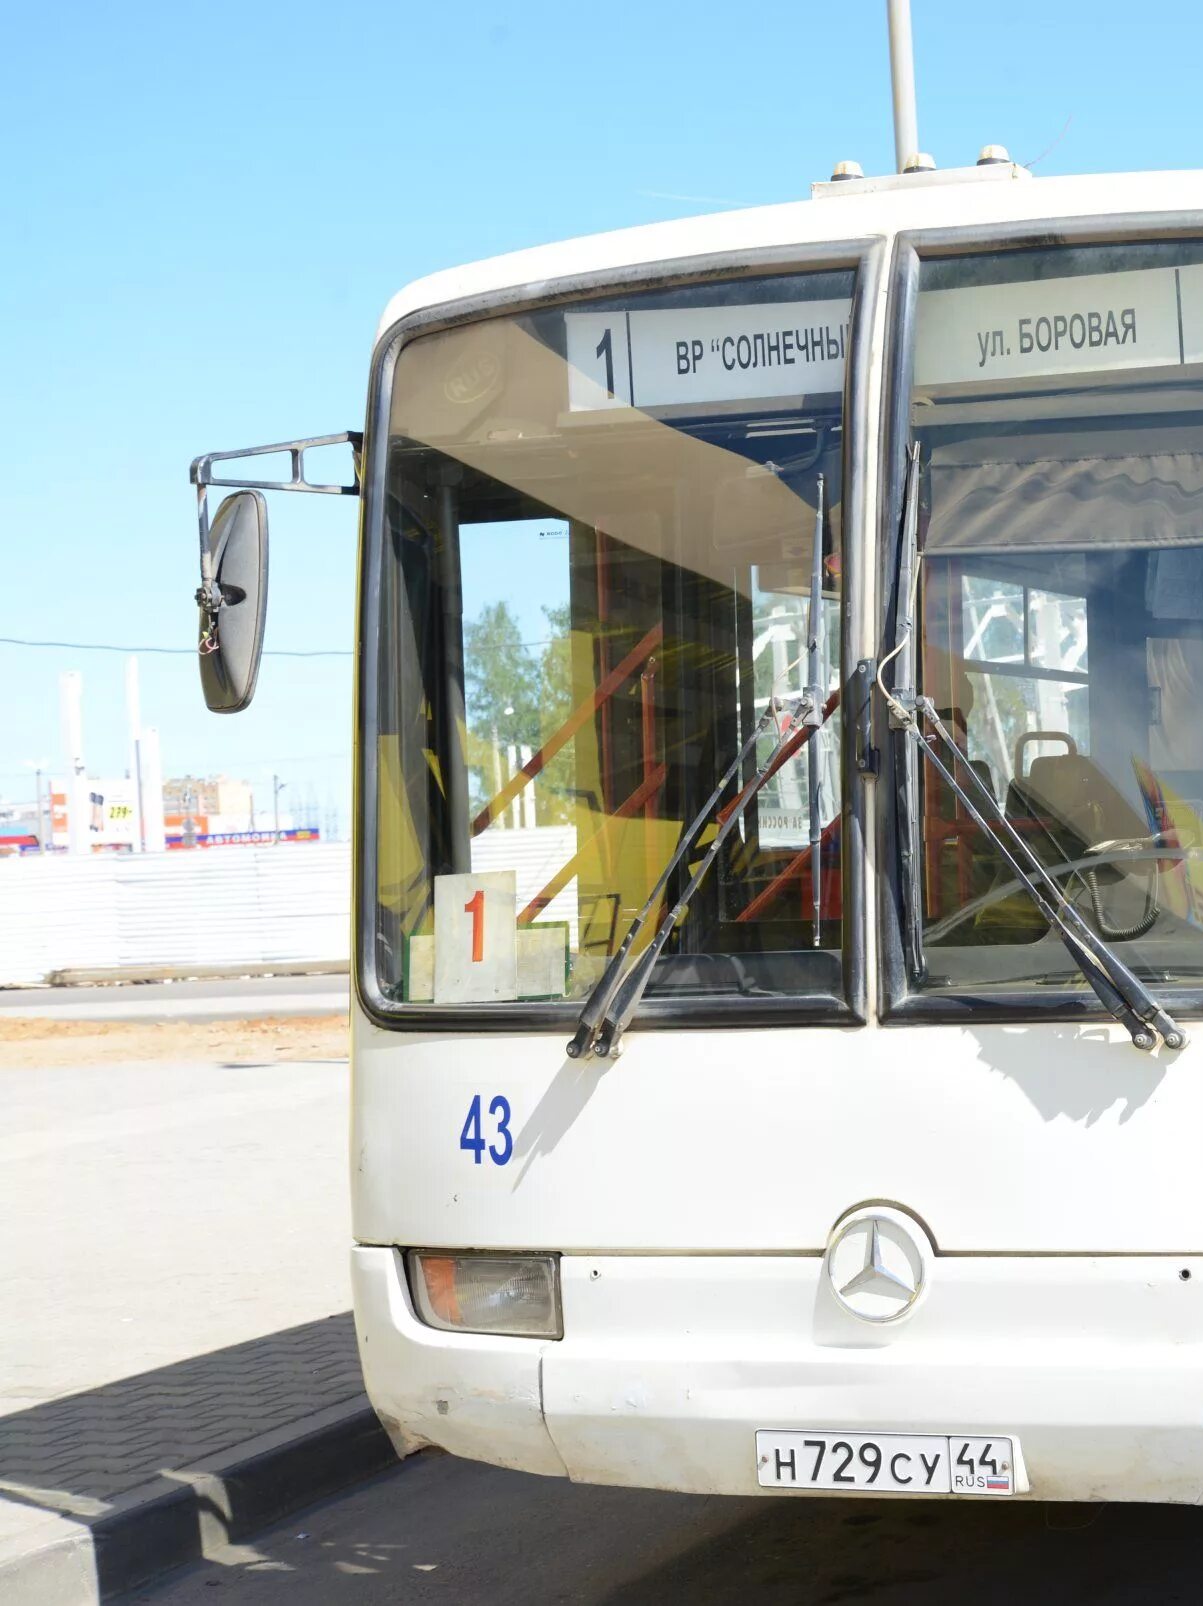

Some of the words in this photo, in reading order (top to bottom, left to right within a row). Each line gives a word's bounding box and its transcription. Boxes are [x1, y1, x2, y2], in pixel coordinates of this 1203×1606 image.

[595, 328, 615, 400] 1
[675, 339, 704, 375] ВР
[711, 322, 850, 371] “СОЛНЕЧНЫ
[976, 329, 1011, 368] ул.
[1018, 307, 1137, 354] БОРОВАЯ
[464, 890, 485, 962] 1
[459, 1094, 513, 1166] 43
[955, 1475, 986, 1488] RUS
[956, 1443, 998, 1475] 44
